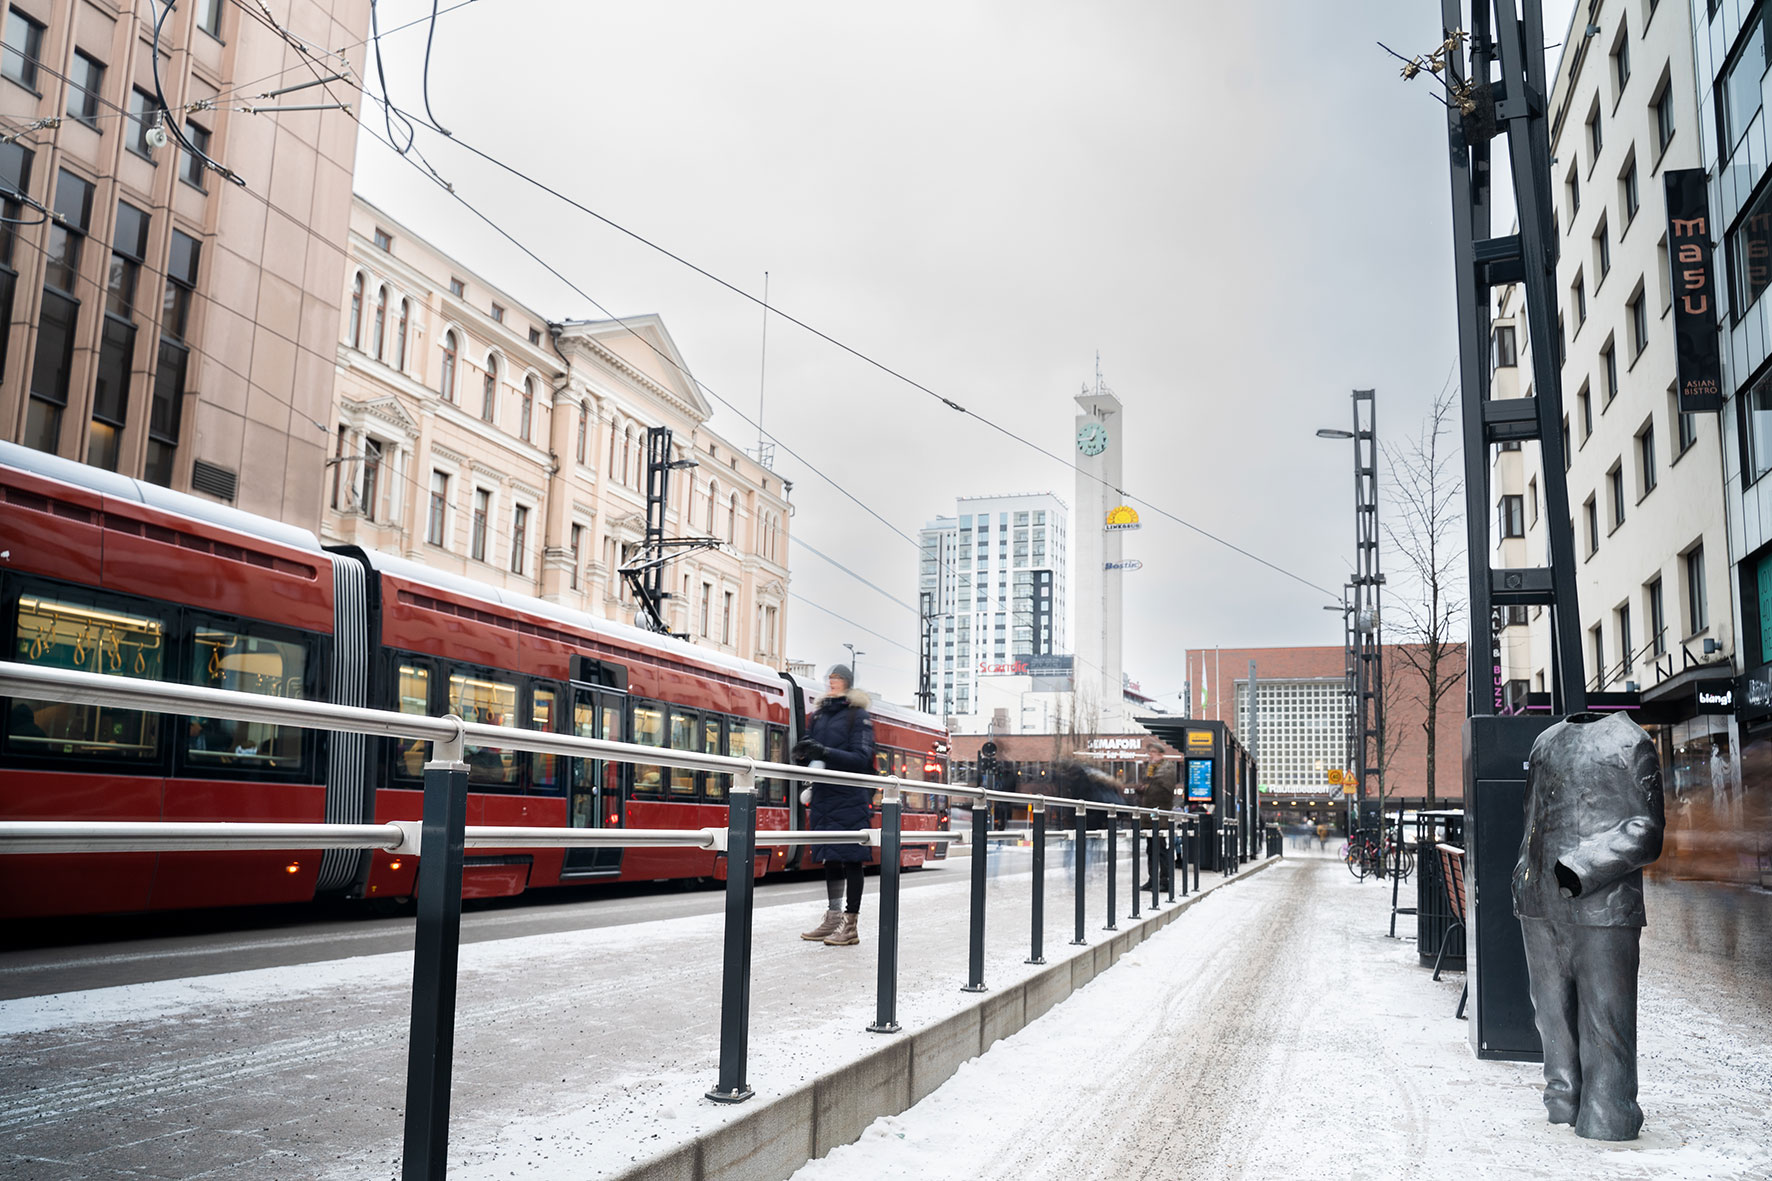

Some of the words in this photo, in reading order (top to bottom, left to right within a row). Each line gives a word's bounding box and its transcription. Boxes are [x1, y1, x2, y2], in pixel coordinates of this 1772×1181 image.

[1671, 216, 1708, 315] masu
[1684, 386, 1718, 395] BISTRO
[1686, 379, 1716, 388] ASIAN
[1491, 605, 1502, 641] ALM
[979, 660, 1029, 673] Scandic
[1493, 665, 1502, 707] BUZZ
